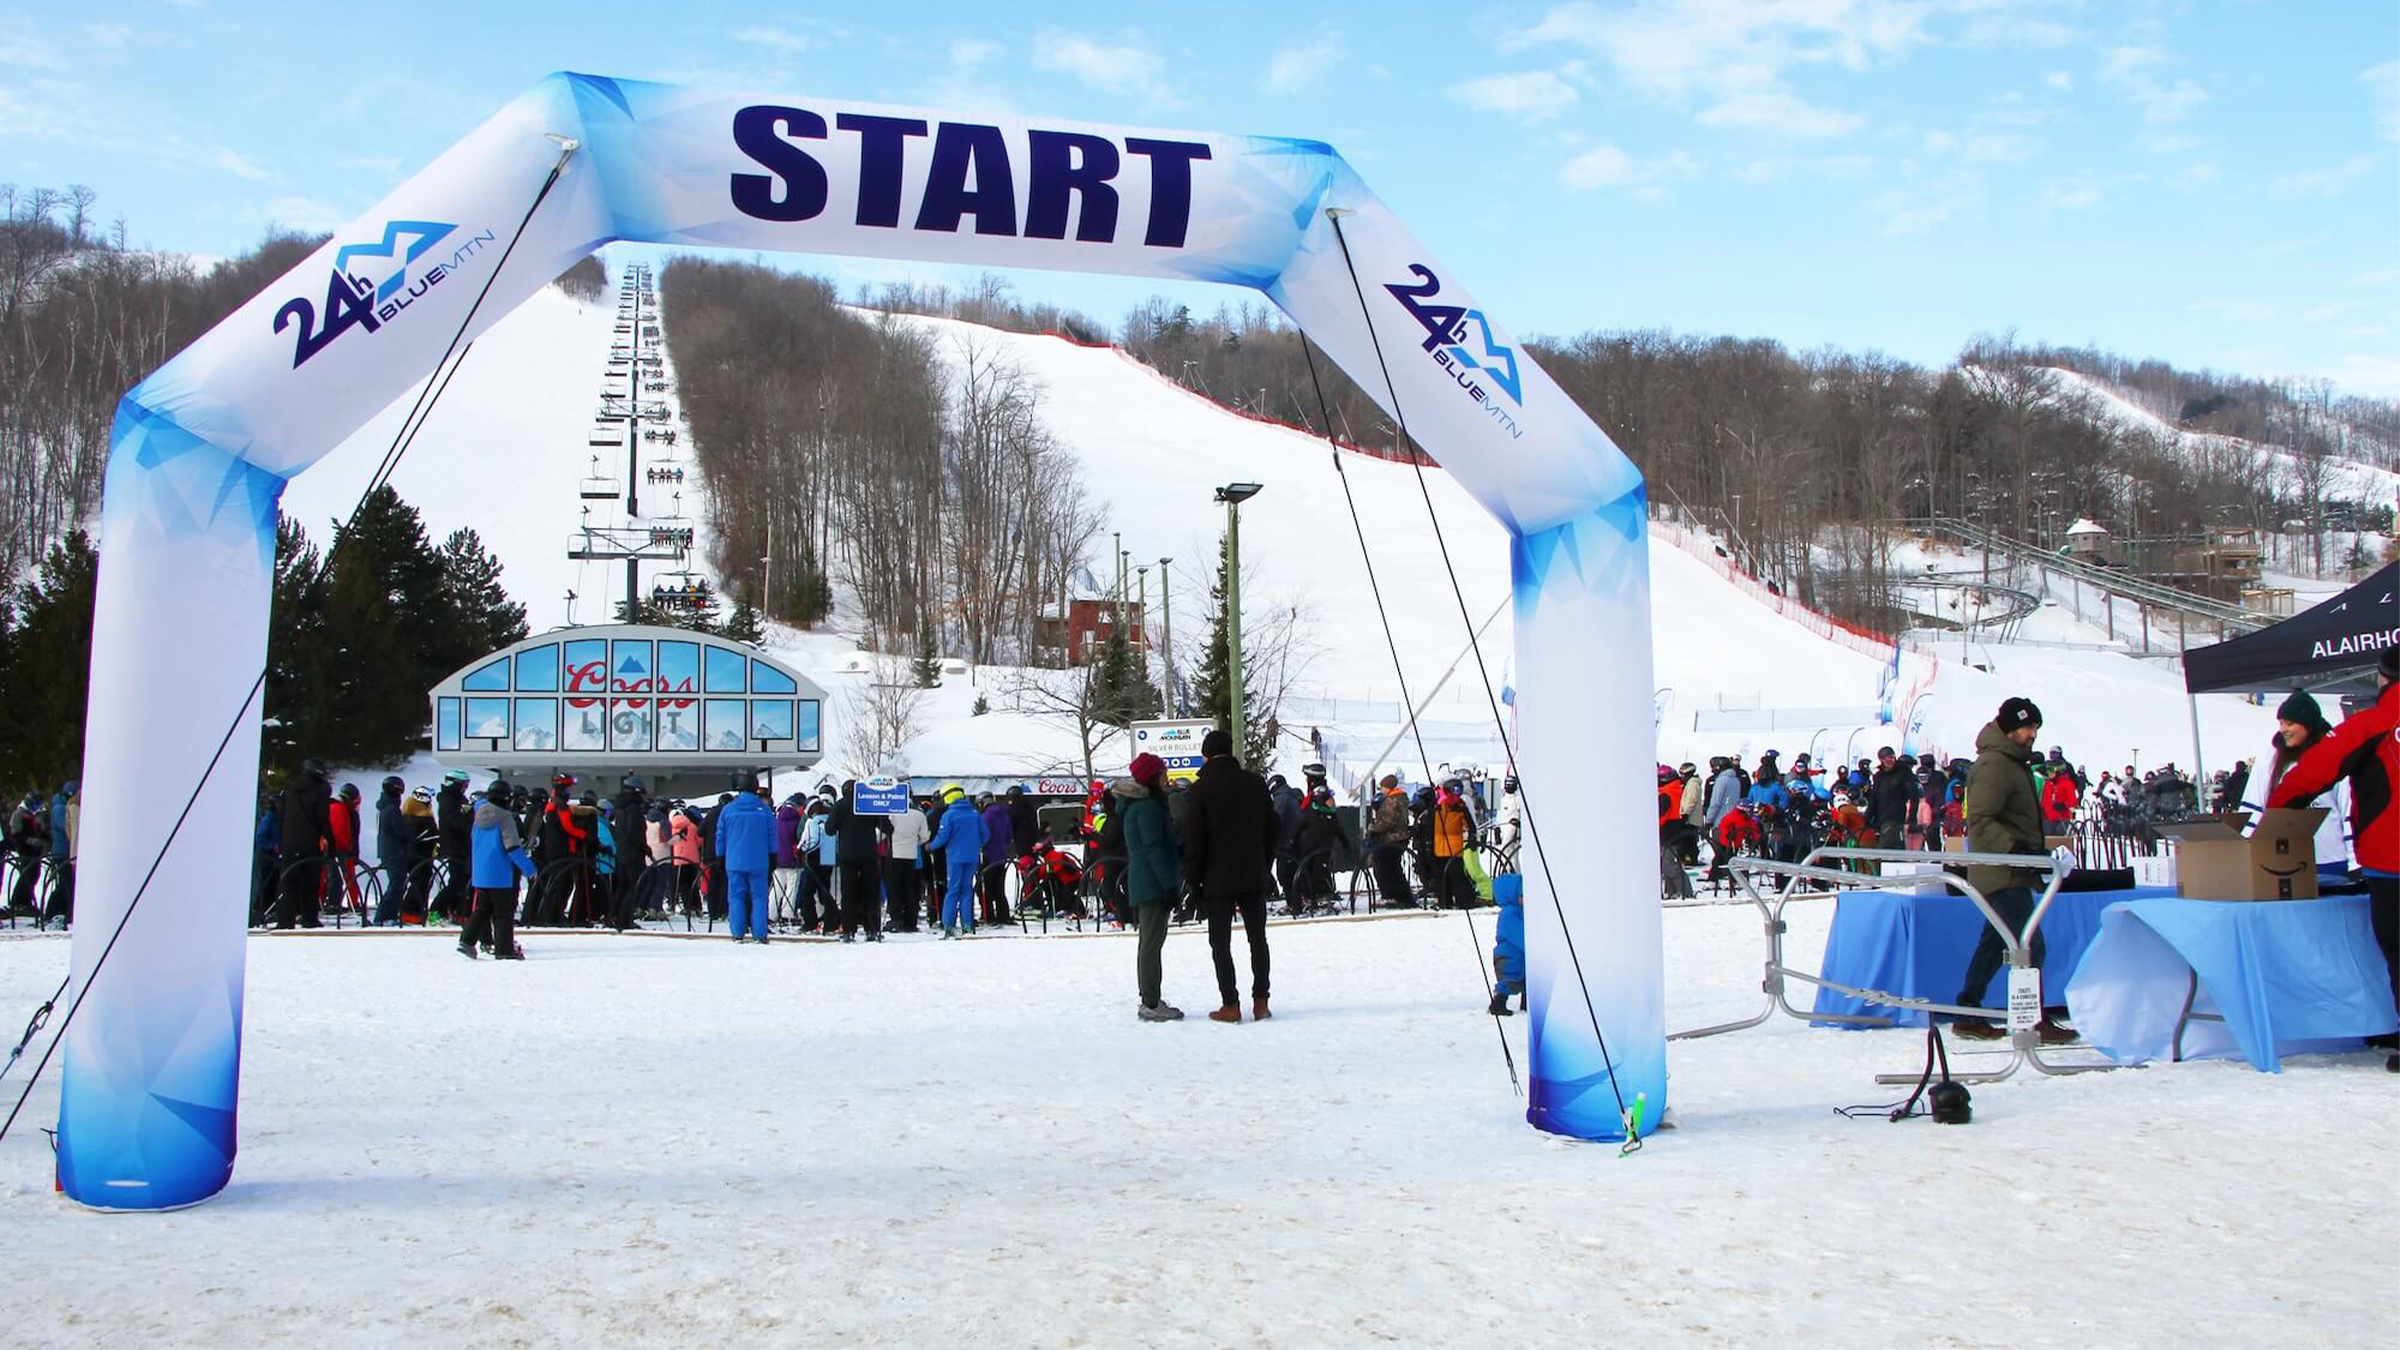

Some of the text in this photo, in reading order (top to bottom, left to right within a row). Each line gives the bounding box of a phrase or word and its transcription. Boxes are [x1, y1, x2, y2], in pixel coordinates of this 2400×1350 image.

[731, 105, 1213, 248] START
[273, 268, 382, 370] 24h
[1382, 263, 1468, 353] 24h
[566, 661, 698, 709] Coors
[582, 711, 683, 735] LIGHT
[1148, 742, 1202, 752] SILVER BULLET
[1038, 779, 1077, 794] Coors
